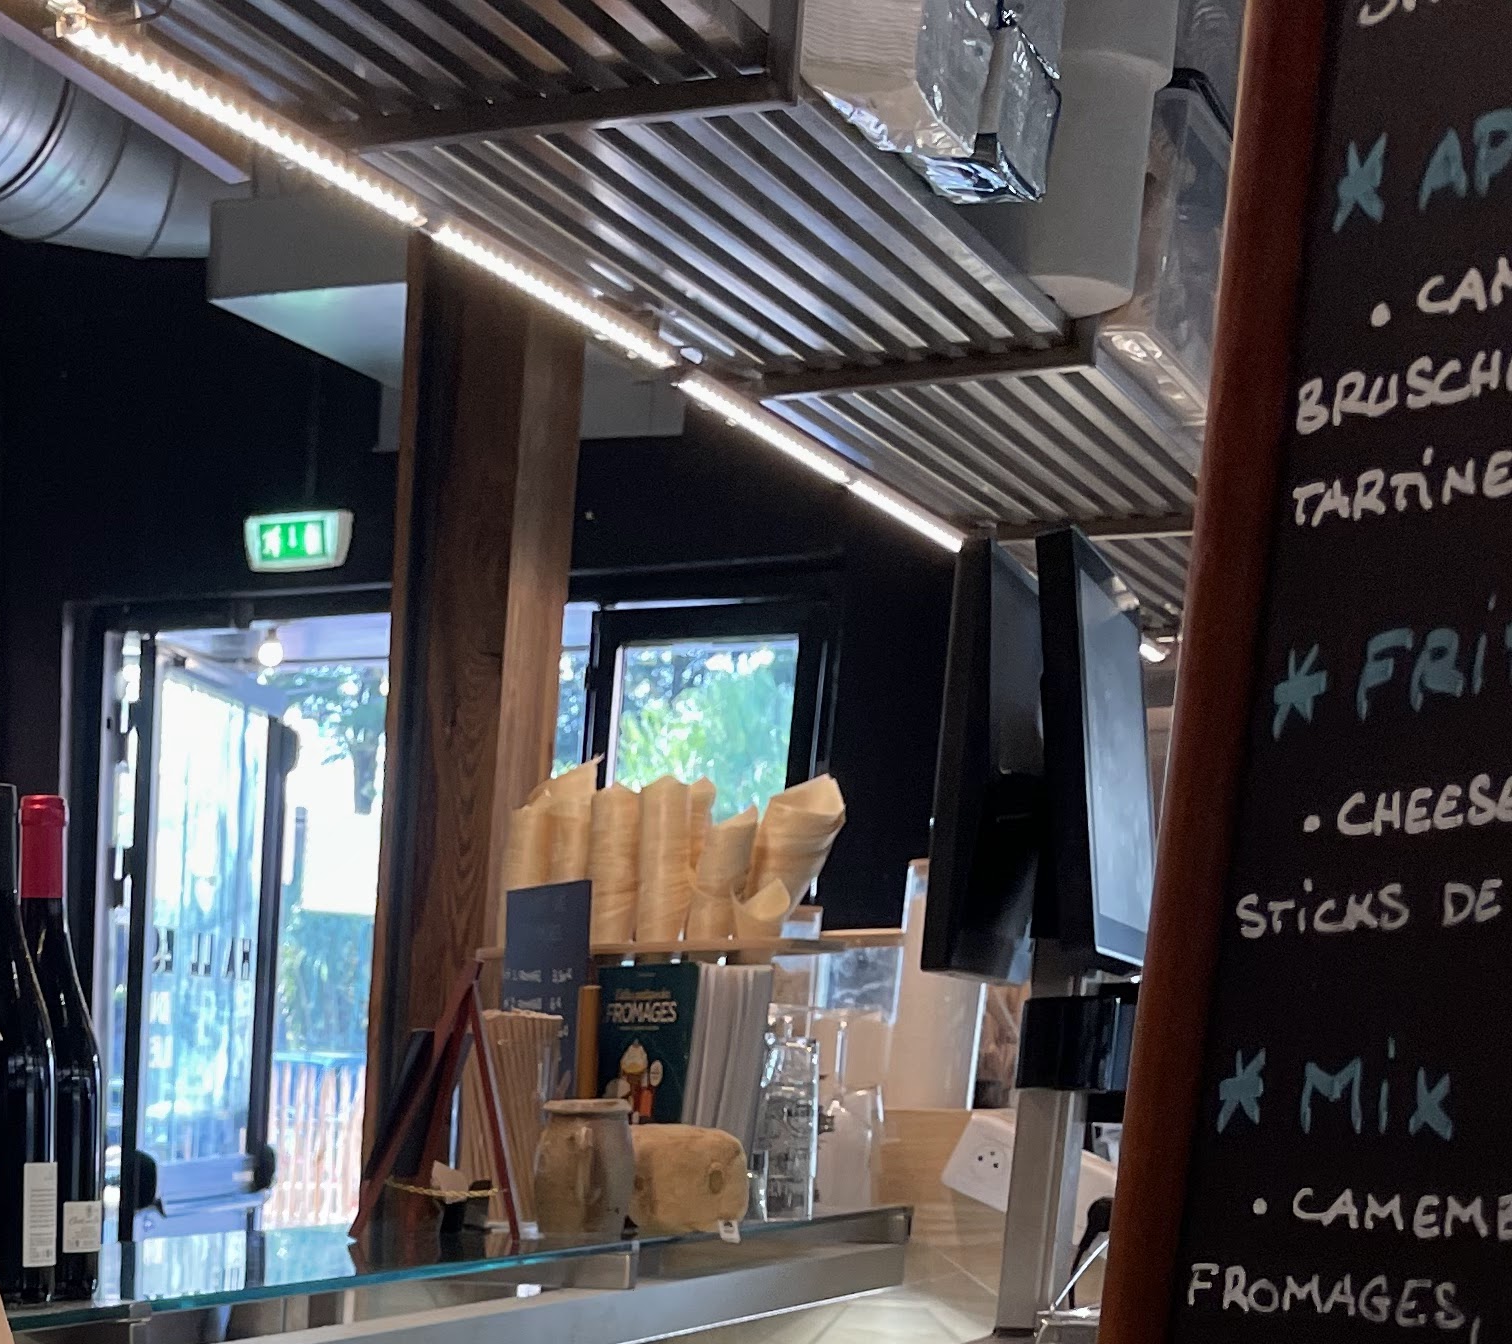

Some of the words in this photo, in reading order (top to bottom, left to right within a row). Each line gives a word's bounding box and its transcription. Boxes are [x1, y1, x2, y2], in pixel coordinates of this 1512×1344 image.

[1295, 349, 1512, 436] BRUSCH
[1441, 878, 1503, 928] DE
[605, 1001, 678, 1024] FROMAGES
